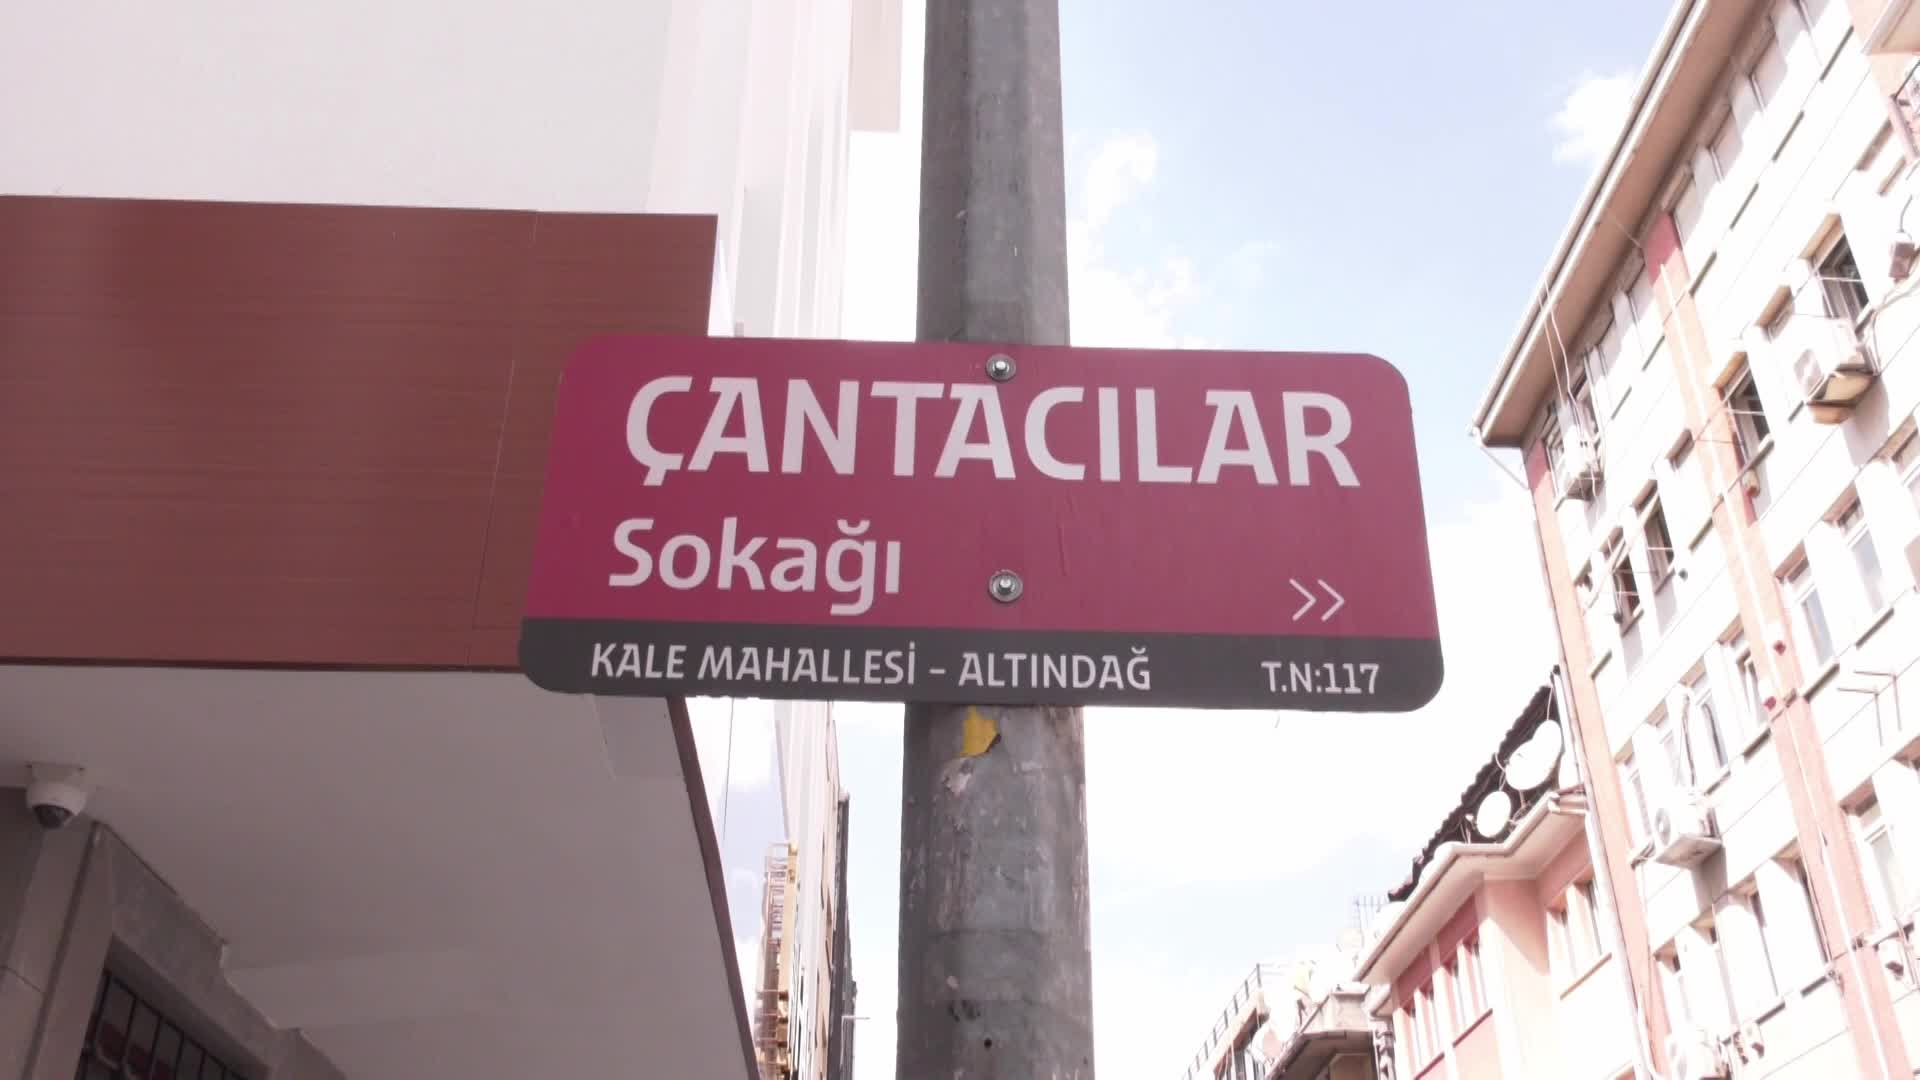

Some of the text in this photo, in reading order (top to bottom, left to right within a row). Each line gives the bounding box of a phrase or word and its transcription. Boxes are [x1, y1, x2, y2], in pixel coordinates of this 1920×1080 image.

[625, 375, 1362, 489] ÇANTACILAR
[608, 515, 902, 616] Sokağı
[590, 642, 686, 679] KALE
[696, 640, 917, 685] MAHALLESİ
[957, 645, 1152, 691] ALTINDAĞ
[1260, 660, 1380, 695] T.N:117
